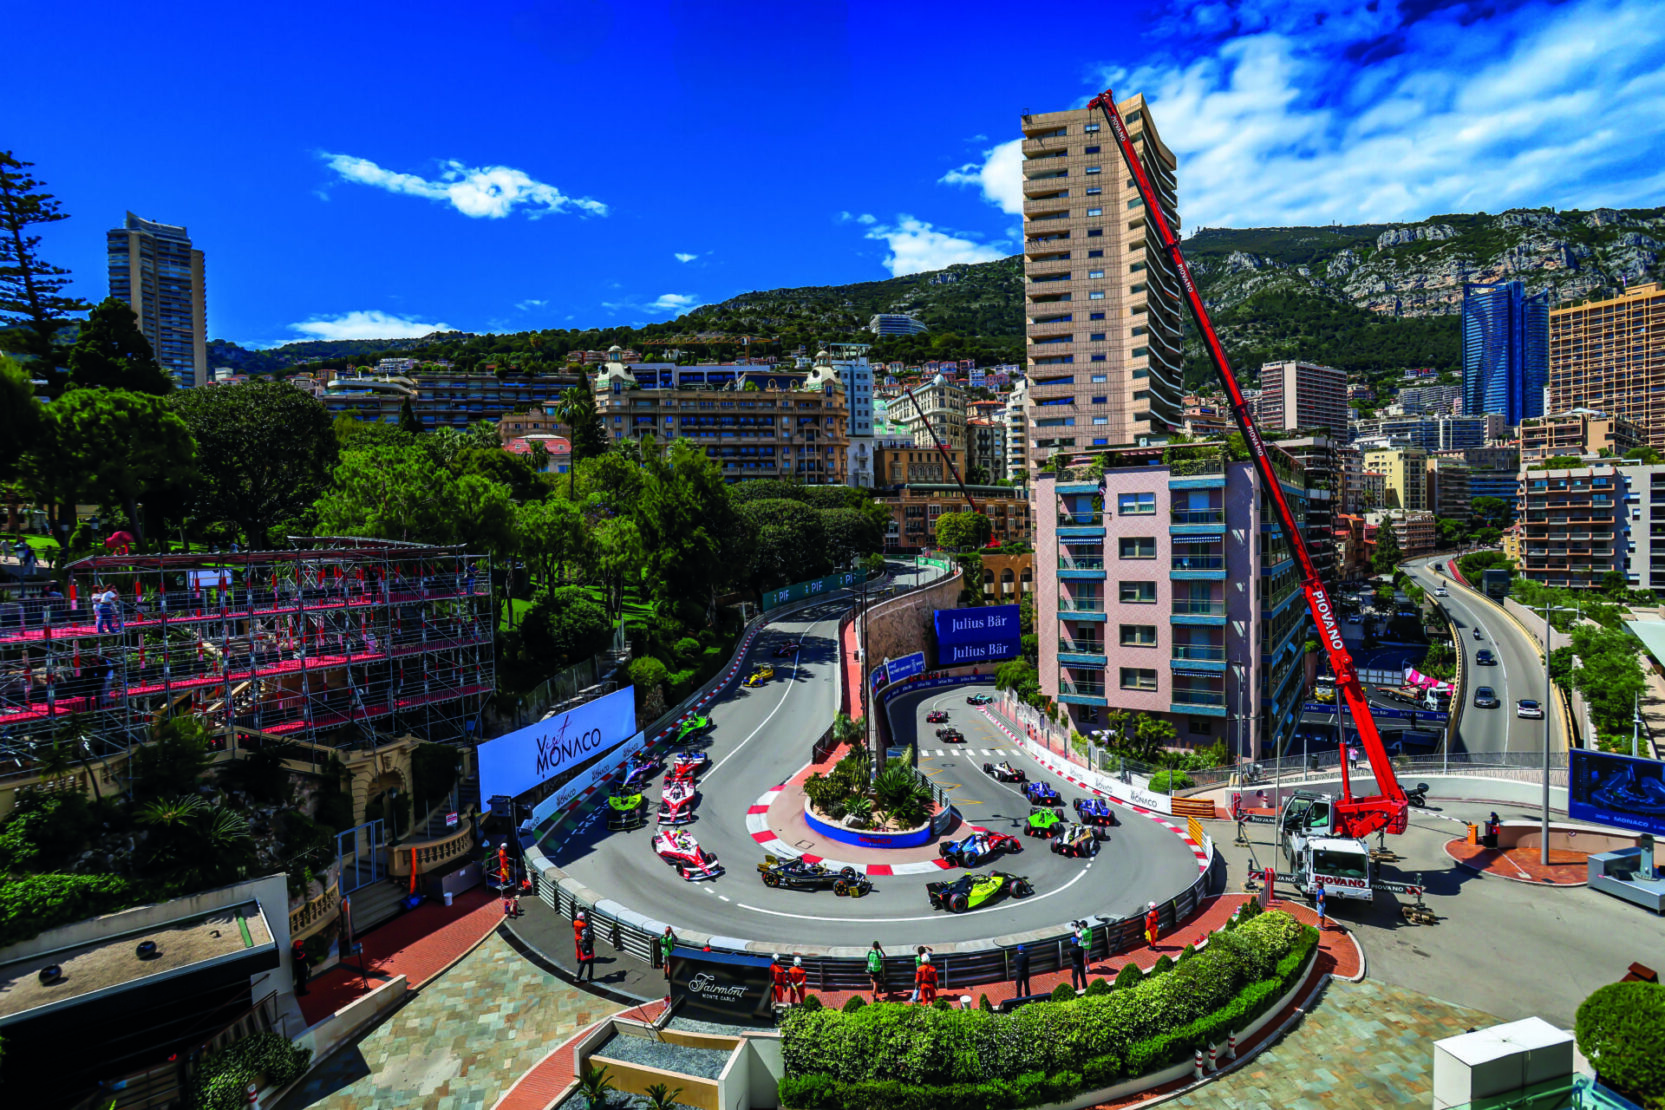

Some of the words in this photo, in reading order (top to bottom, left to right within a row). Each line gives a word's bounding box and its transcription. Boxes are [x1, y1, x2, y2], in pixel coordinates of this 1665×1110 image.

[1177, 263, 1194, 293] PIOVANO
[1247, 425, 1264, 457] PIOVANO
[811, 580, 823, 592] PIF
[779, 590, 790, 601] PIF
[952, 617, 984, 633] Julius
[987, 615, 1008, 628] Bär
[1312, 590, 1343, 650] PIOVANO
[953, 646, 985, 662] Julius
[988, 643, 1009, 656] Bär
[536, 714, 572, 756] Visit
[536, 728, 601, 776] MONACO
[1613, 816, 1649, 828] MONACO
[858, 836, 892, 845] MONACO
[1314, 875, 1366, 888] PIOVANO
[1371, 884, 1404, 892] PIOVANO
[688, 972, 749, 998] Fairmont
